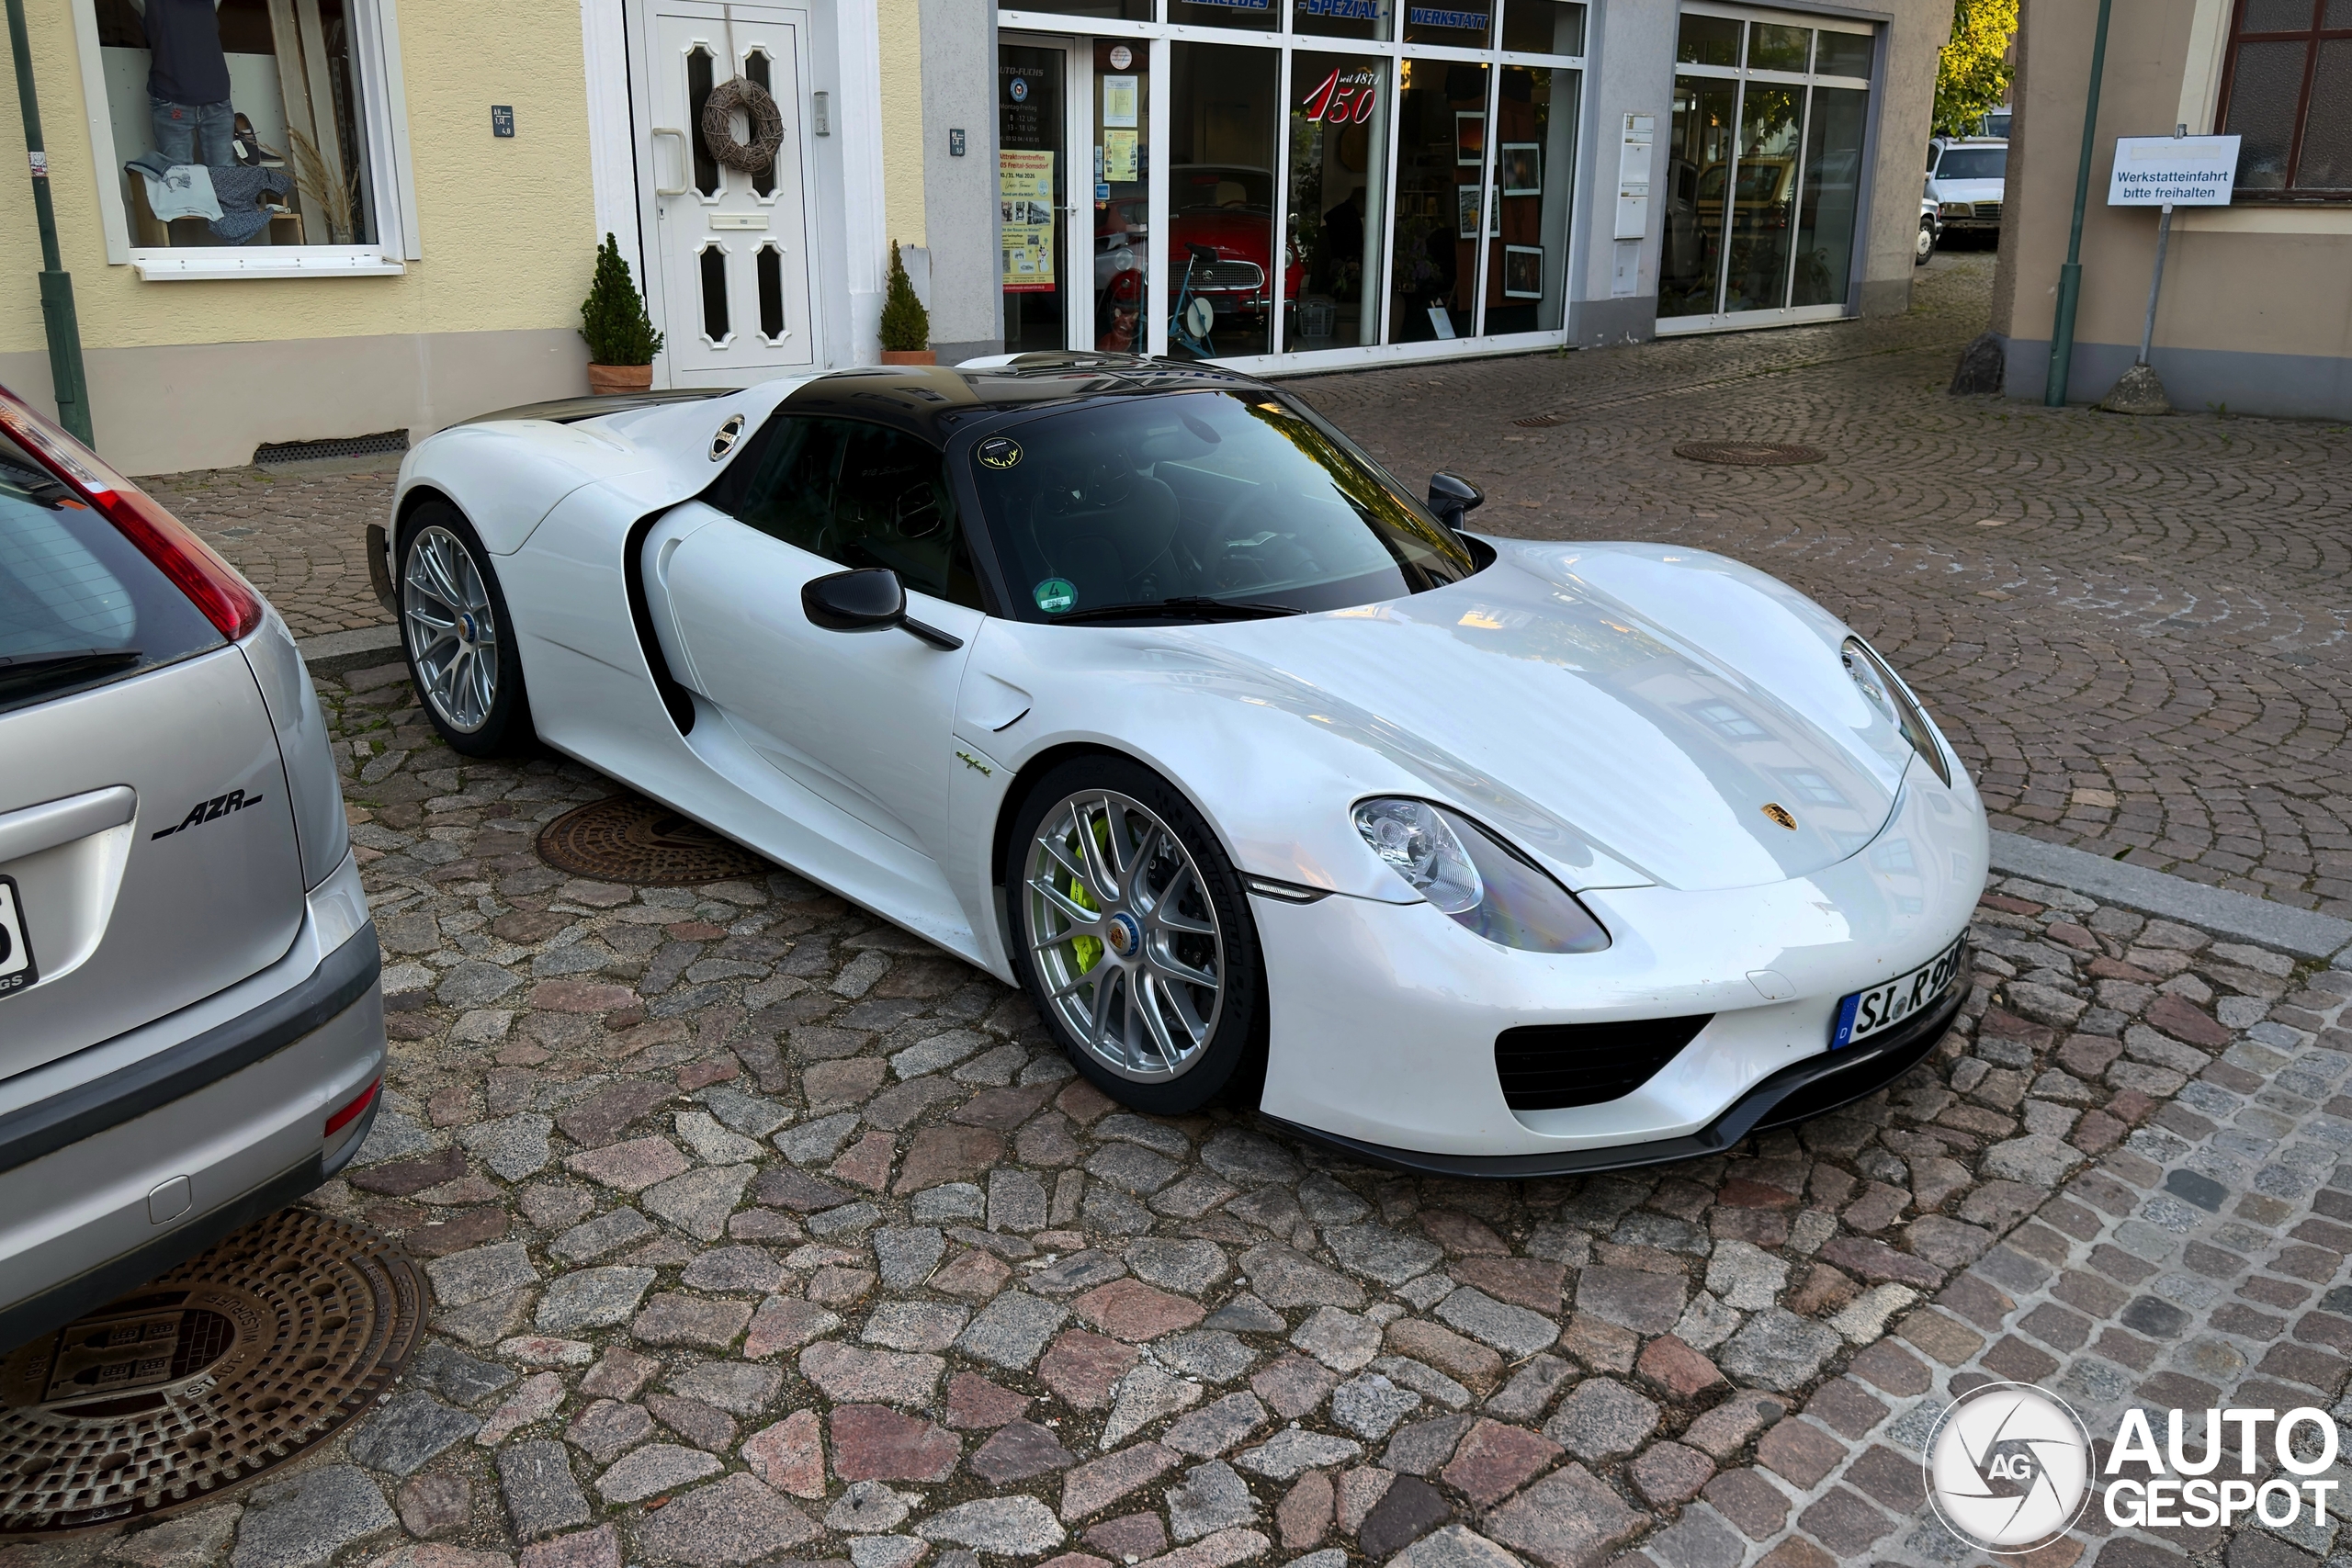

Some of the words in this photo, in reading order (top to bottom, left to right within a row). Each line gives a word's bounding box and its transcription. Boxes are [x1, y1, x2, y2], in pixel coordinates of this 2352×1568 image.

[1411, 7, 1488, 30] WERKSTATT
[1339, 74, 1353, 84] seit
[1354, 73, 1381, 85] 1871
[1303, 66, 1376, 124] 150
[2118, 171, 2228, 183] Werkstatteinfahrt
[2123, 187, 2152, 198] bitte
[2154, 187, 2215, 198] freihalten
[1048, 582, 1060, 597] 4
[175, 788, 245, 833] AZR
[1199, 851, 1243, 965] MICHELIN
[1839, 1027, 1848, 1040] D
[205, 1294, 259, 1344] WILSDRUFF
[187, 1359, 243, 1395] STADT
